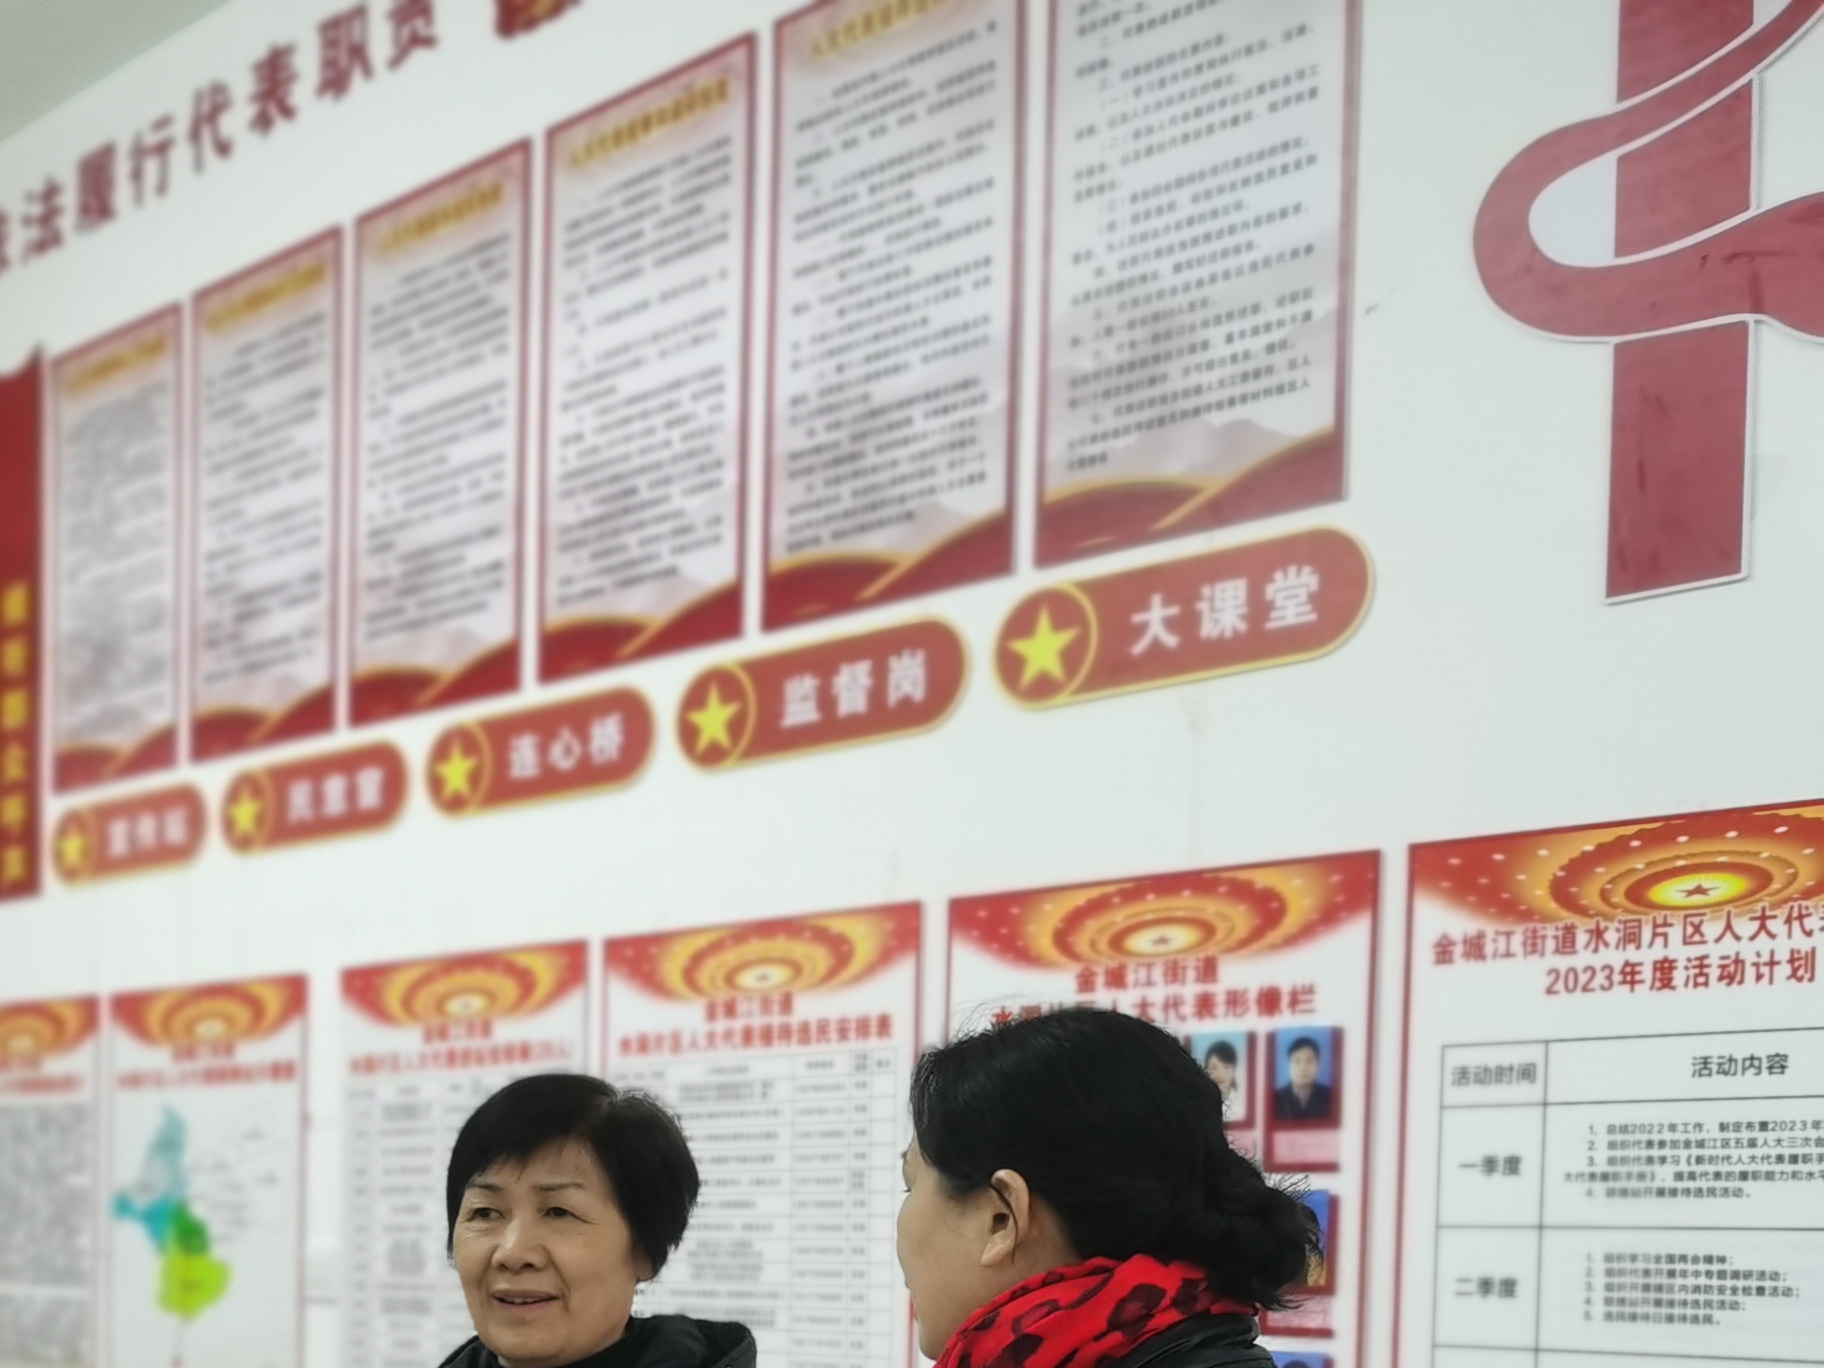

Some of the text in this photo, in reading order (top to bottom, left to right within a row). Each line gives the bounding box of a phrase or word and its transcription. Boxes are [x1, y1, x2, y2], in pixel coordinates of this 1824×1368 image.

[1129, 564, 1320, 657] 大课堂
[779, 649, 928, 730] 监督岗
[507, 713, 624, 781] 连心桥
[1074, 954, 1220, 995] 金城江街道
[1544, 945, 1817, 996] 2023年度活动计划
[1450, 1061, 1538, 1088] 活动时间
[1690, 1052, 1790, 1080] 活动内容
[1457, 1154, 1522, 1178] 一季度
[1454, 1276, 1519, 1300] 二季度
